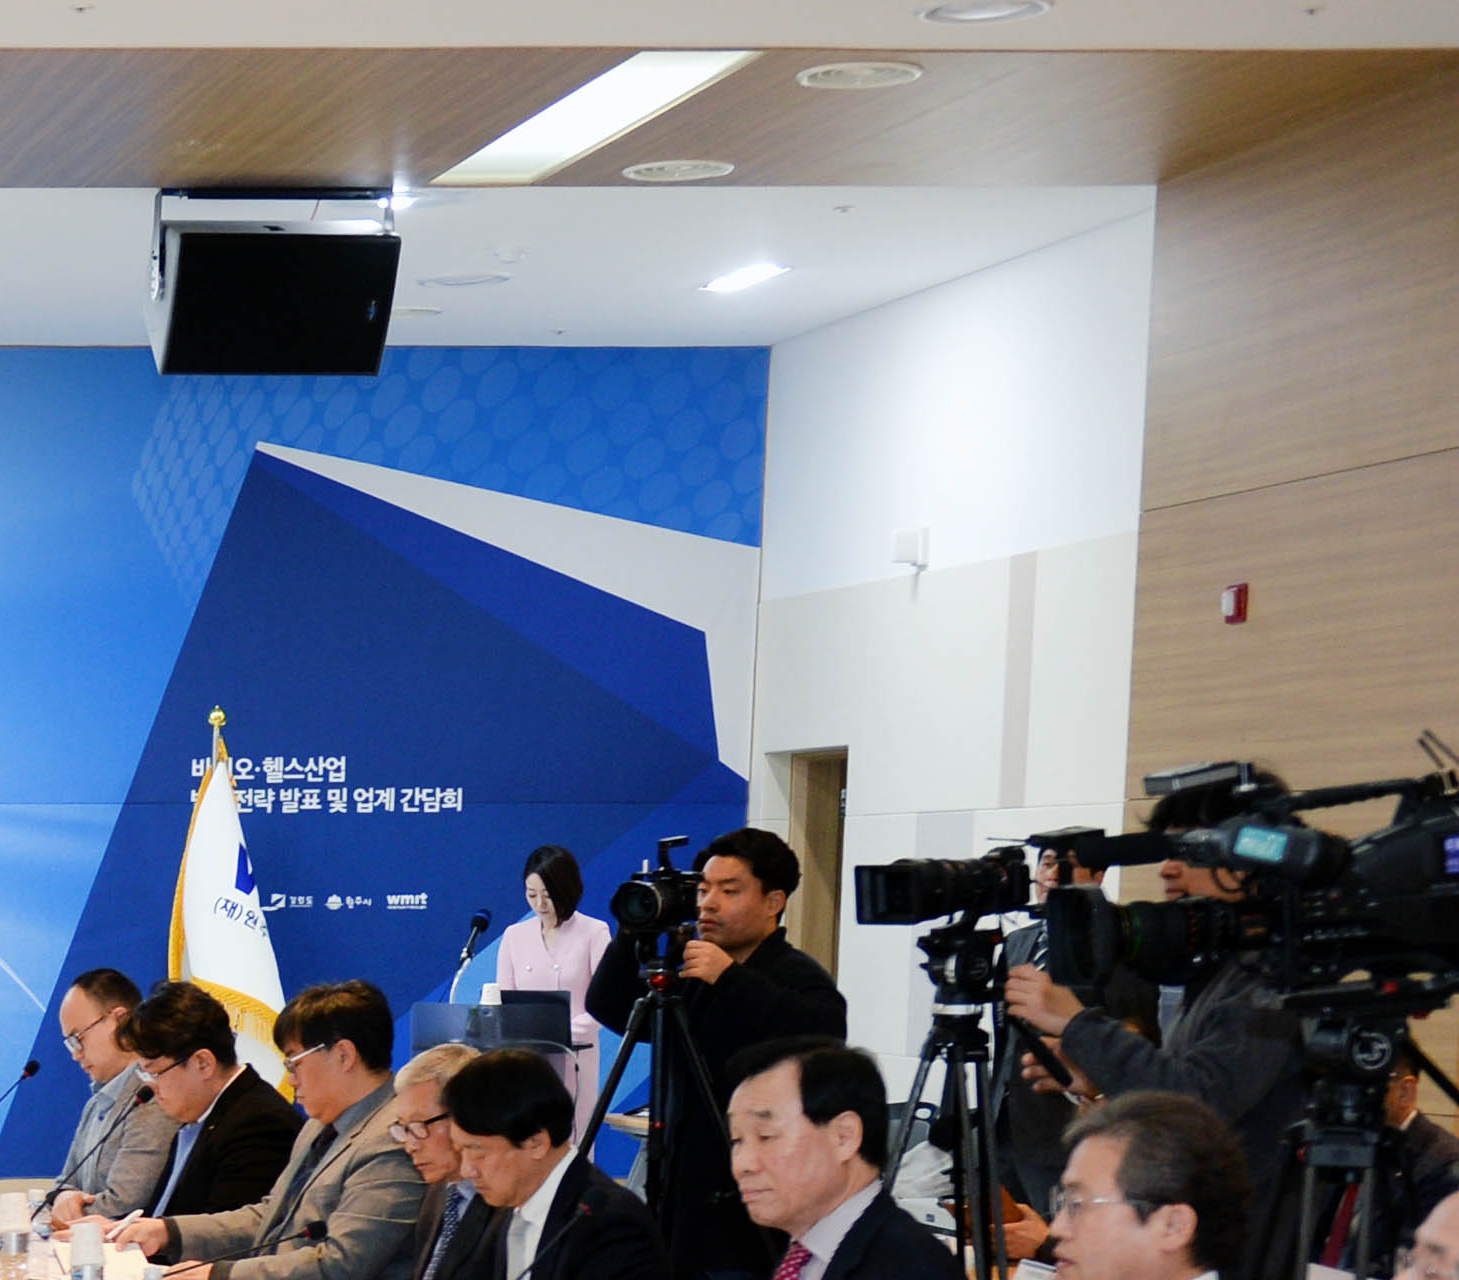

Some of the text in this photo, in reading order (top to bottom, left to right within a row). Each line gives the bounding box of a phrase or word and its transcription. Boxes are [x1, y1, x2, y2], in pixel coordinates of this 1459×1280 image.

[280, 788, 322, 813] 발표
[327, 788, 348, 813] 및
[353, 788, 395, 813] 업계
[400, 787, 463, 813] 간담회
[386, 892, 429, 905] wmit
